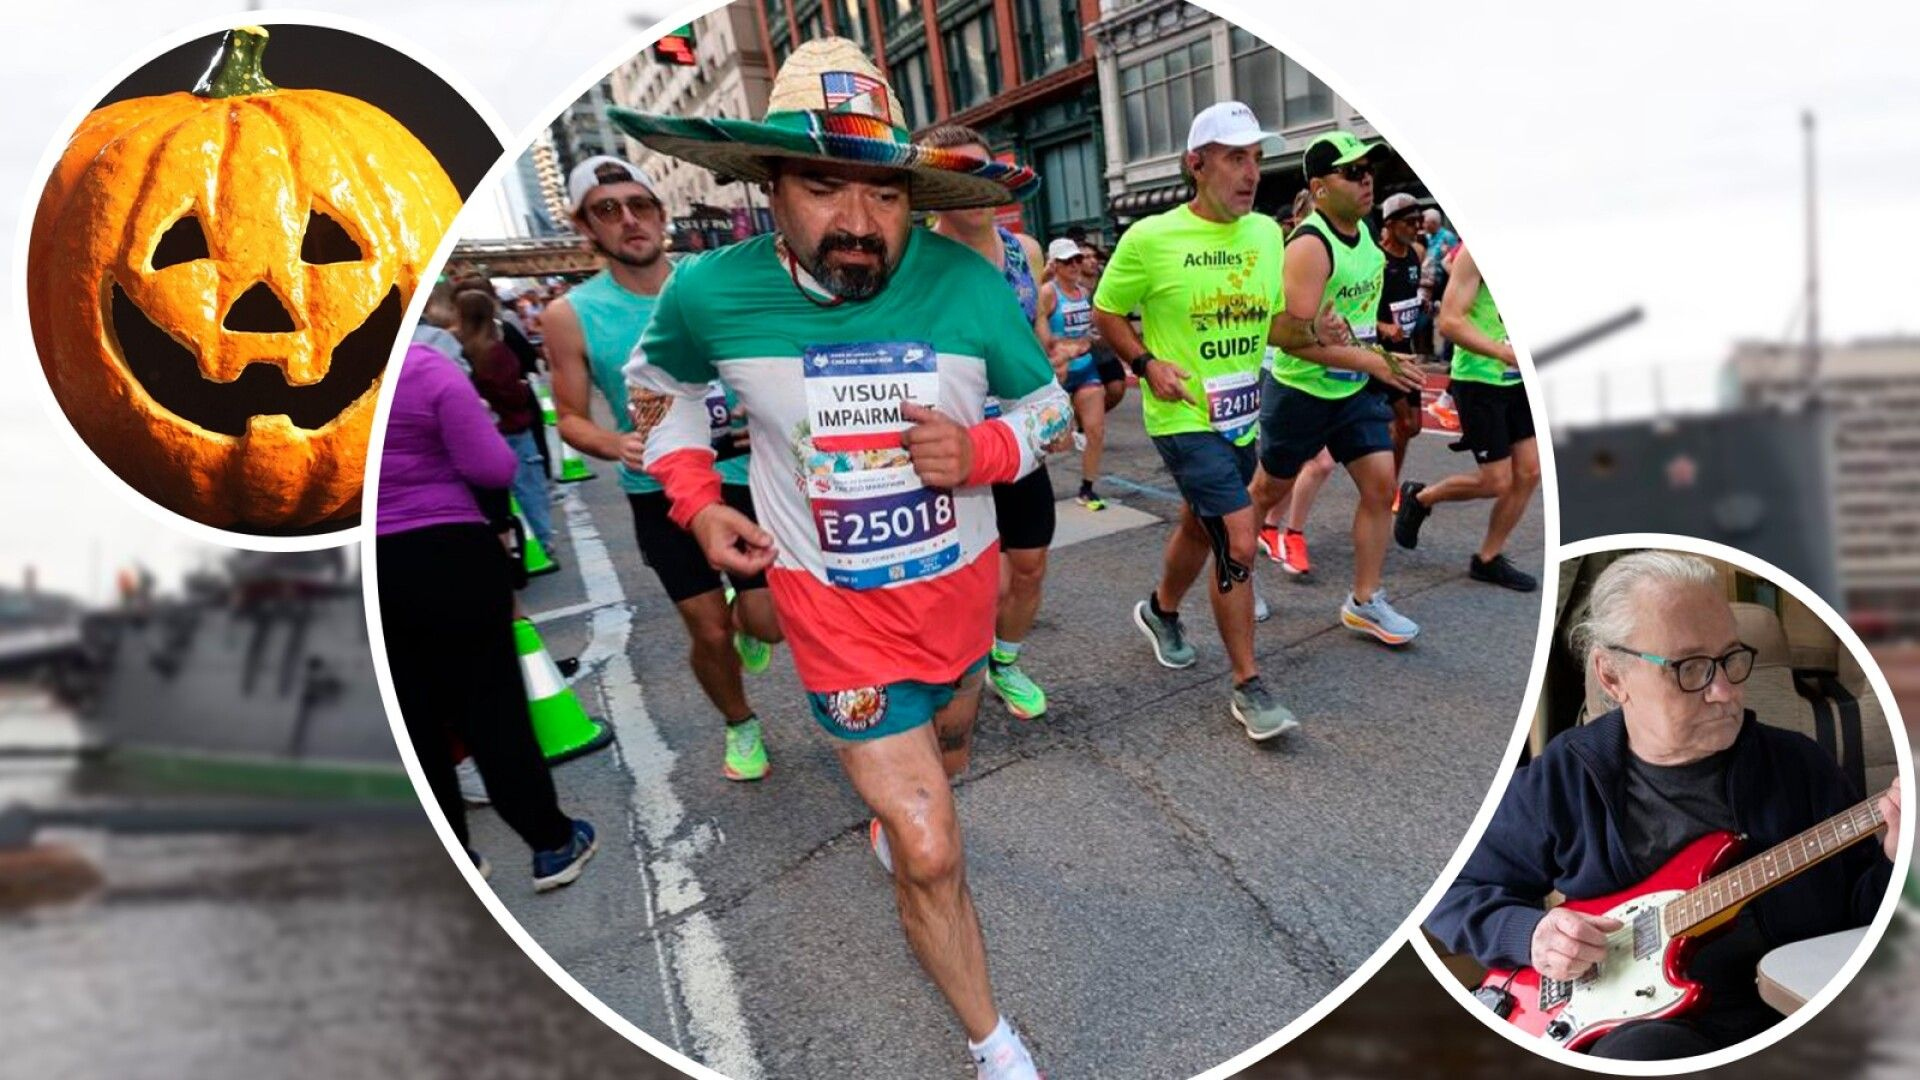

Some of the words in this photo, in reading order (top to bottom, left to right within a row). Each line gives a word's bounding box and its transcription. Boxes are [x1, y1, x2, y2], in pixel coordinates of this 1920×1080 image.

[1183, 250, 1243, 268] Achilles
[1336, 279, 1375, 299] Achilles
[1200, 335, 1260, 360] GUIDE
[832, 382, 918, 402] VISUAL
[818, 403, 936, 428] IMPAIRMT
